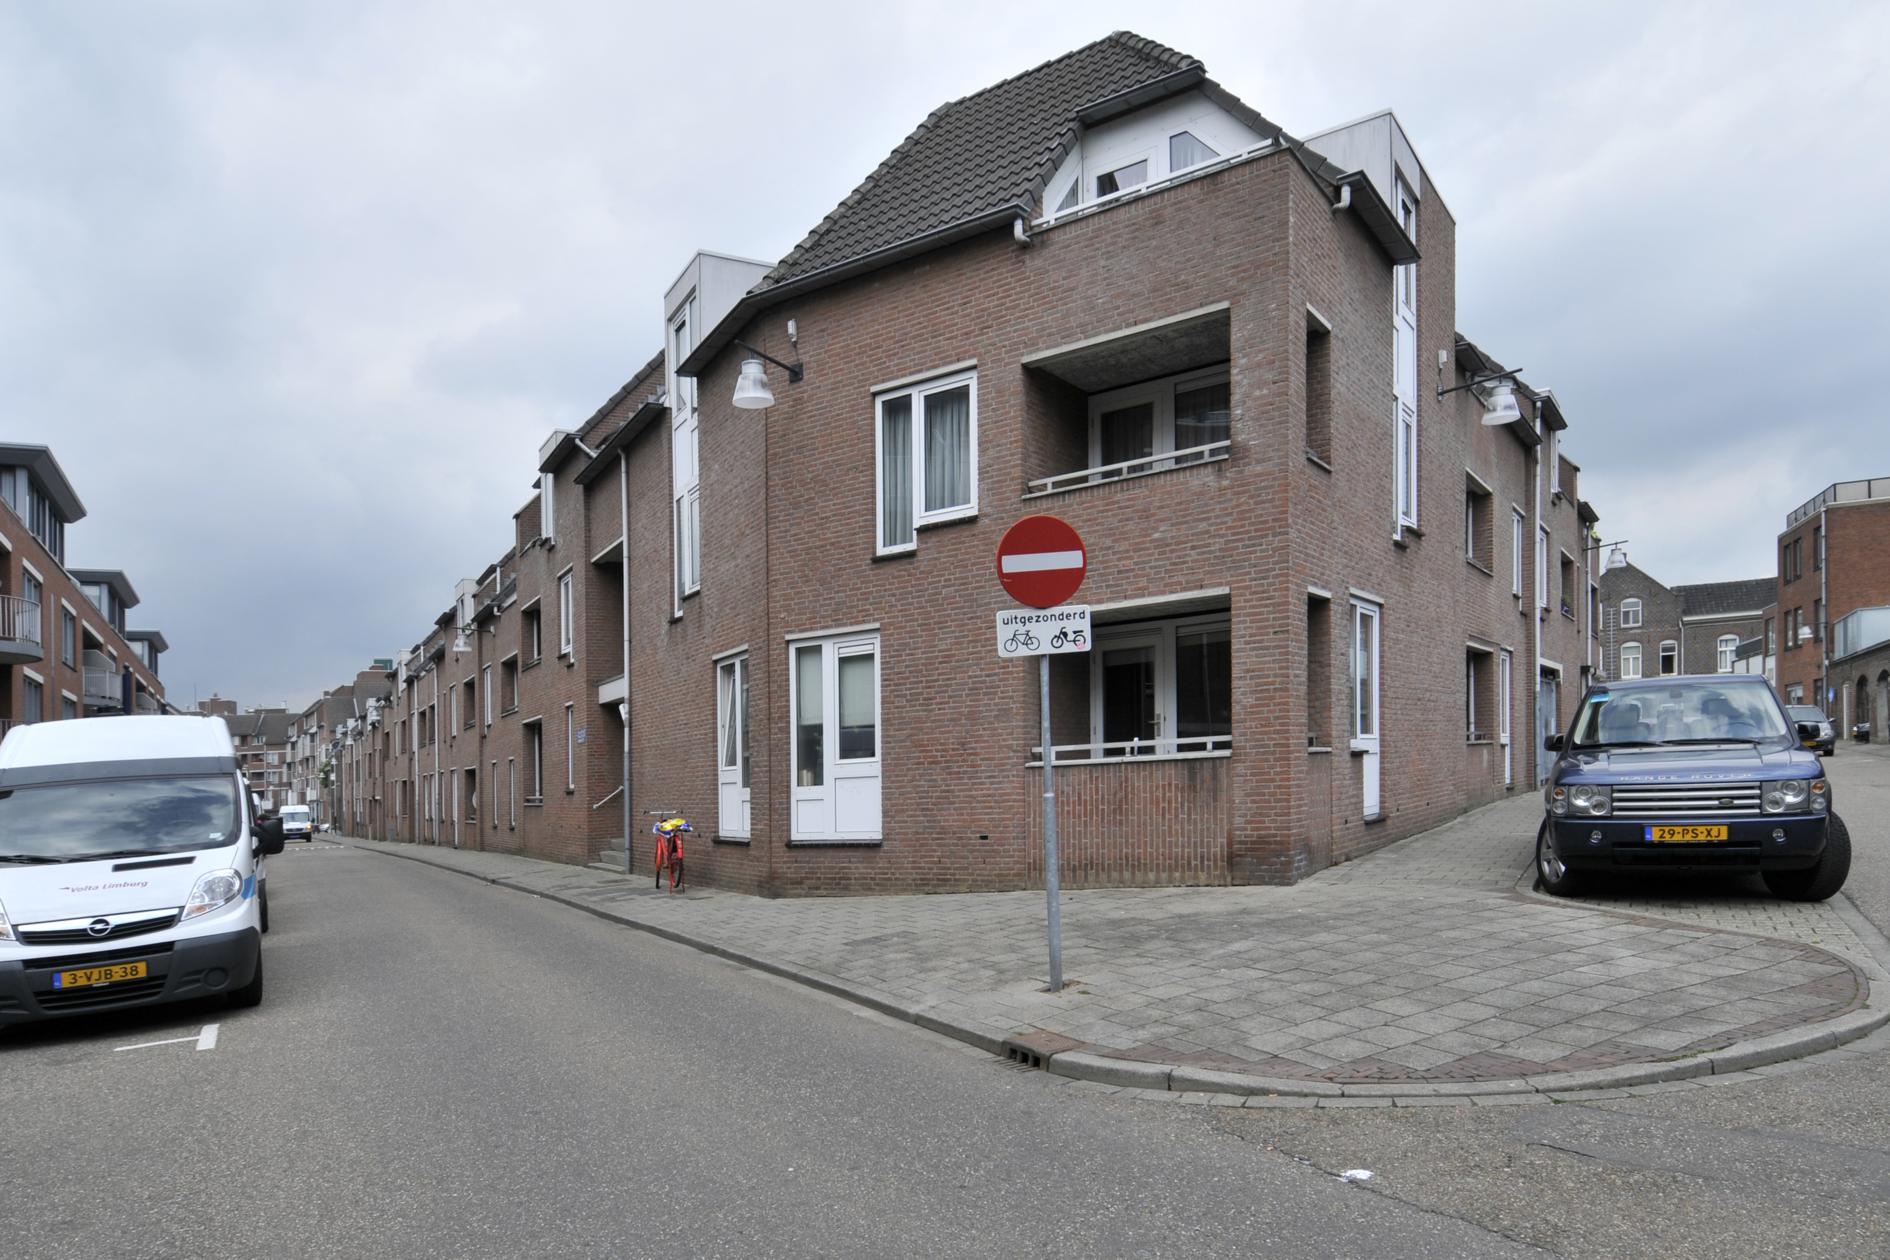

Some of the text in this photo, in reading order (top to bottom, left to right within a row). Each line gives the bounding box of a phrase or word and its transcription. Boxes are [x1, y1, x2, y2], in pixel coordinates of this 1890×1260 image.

[1002, 610, 1086, 627] uitgezonderd
[1658, 827, 1721, 839] 29-PS-XJ
[103, 881, 149, 890] Limburg
[68, 965, 139, 985] 3-VJB-38
